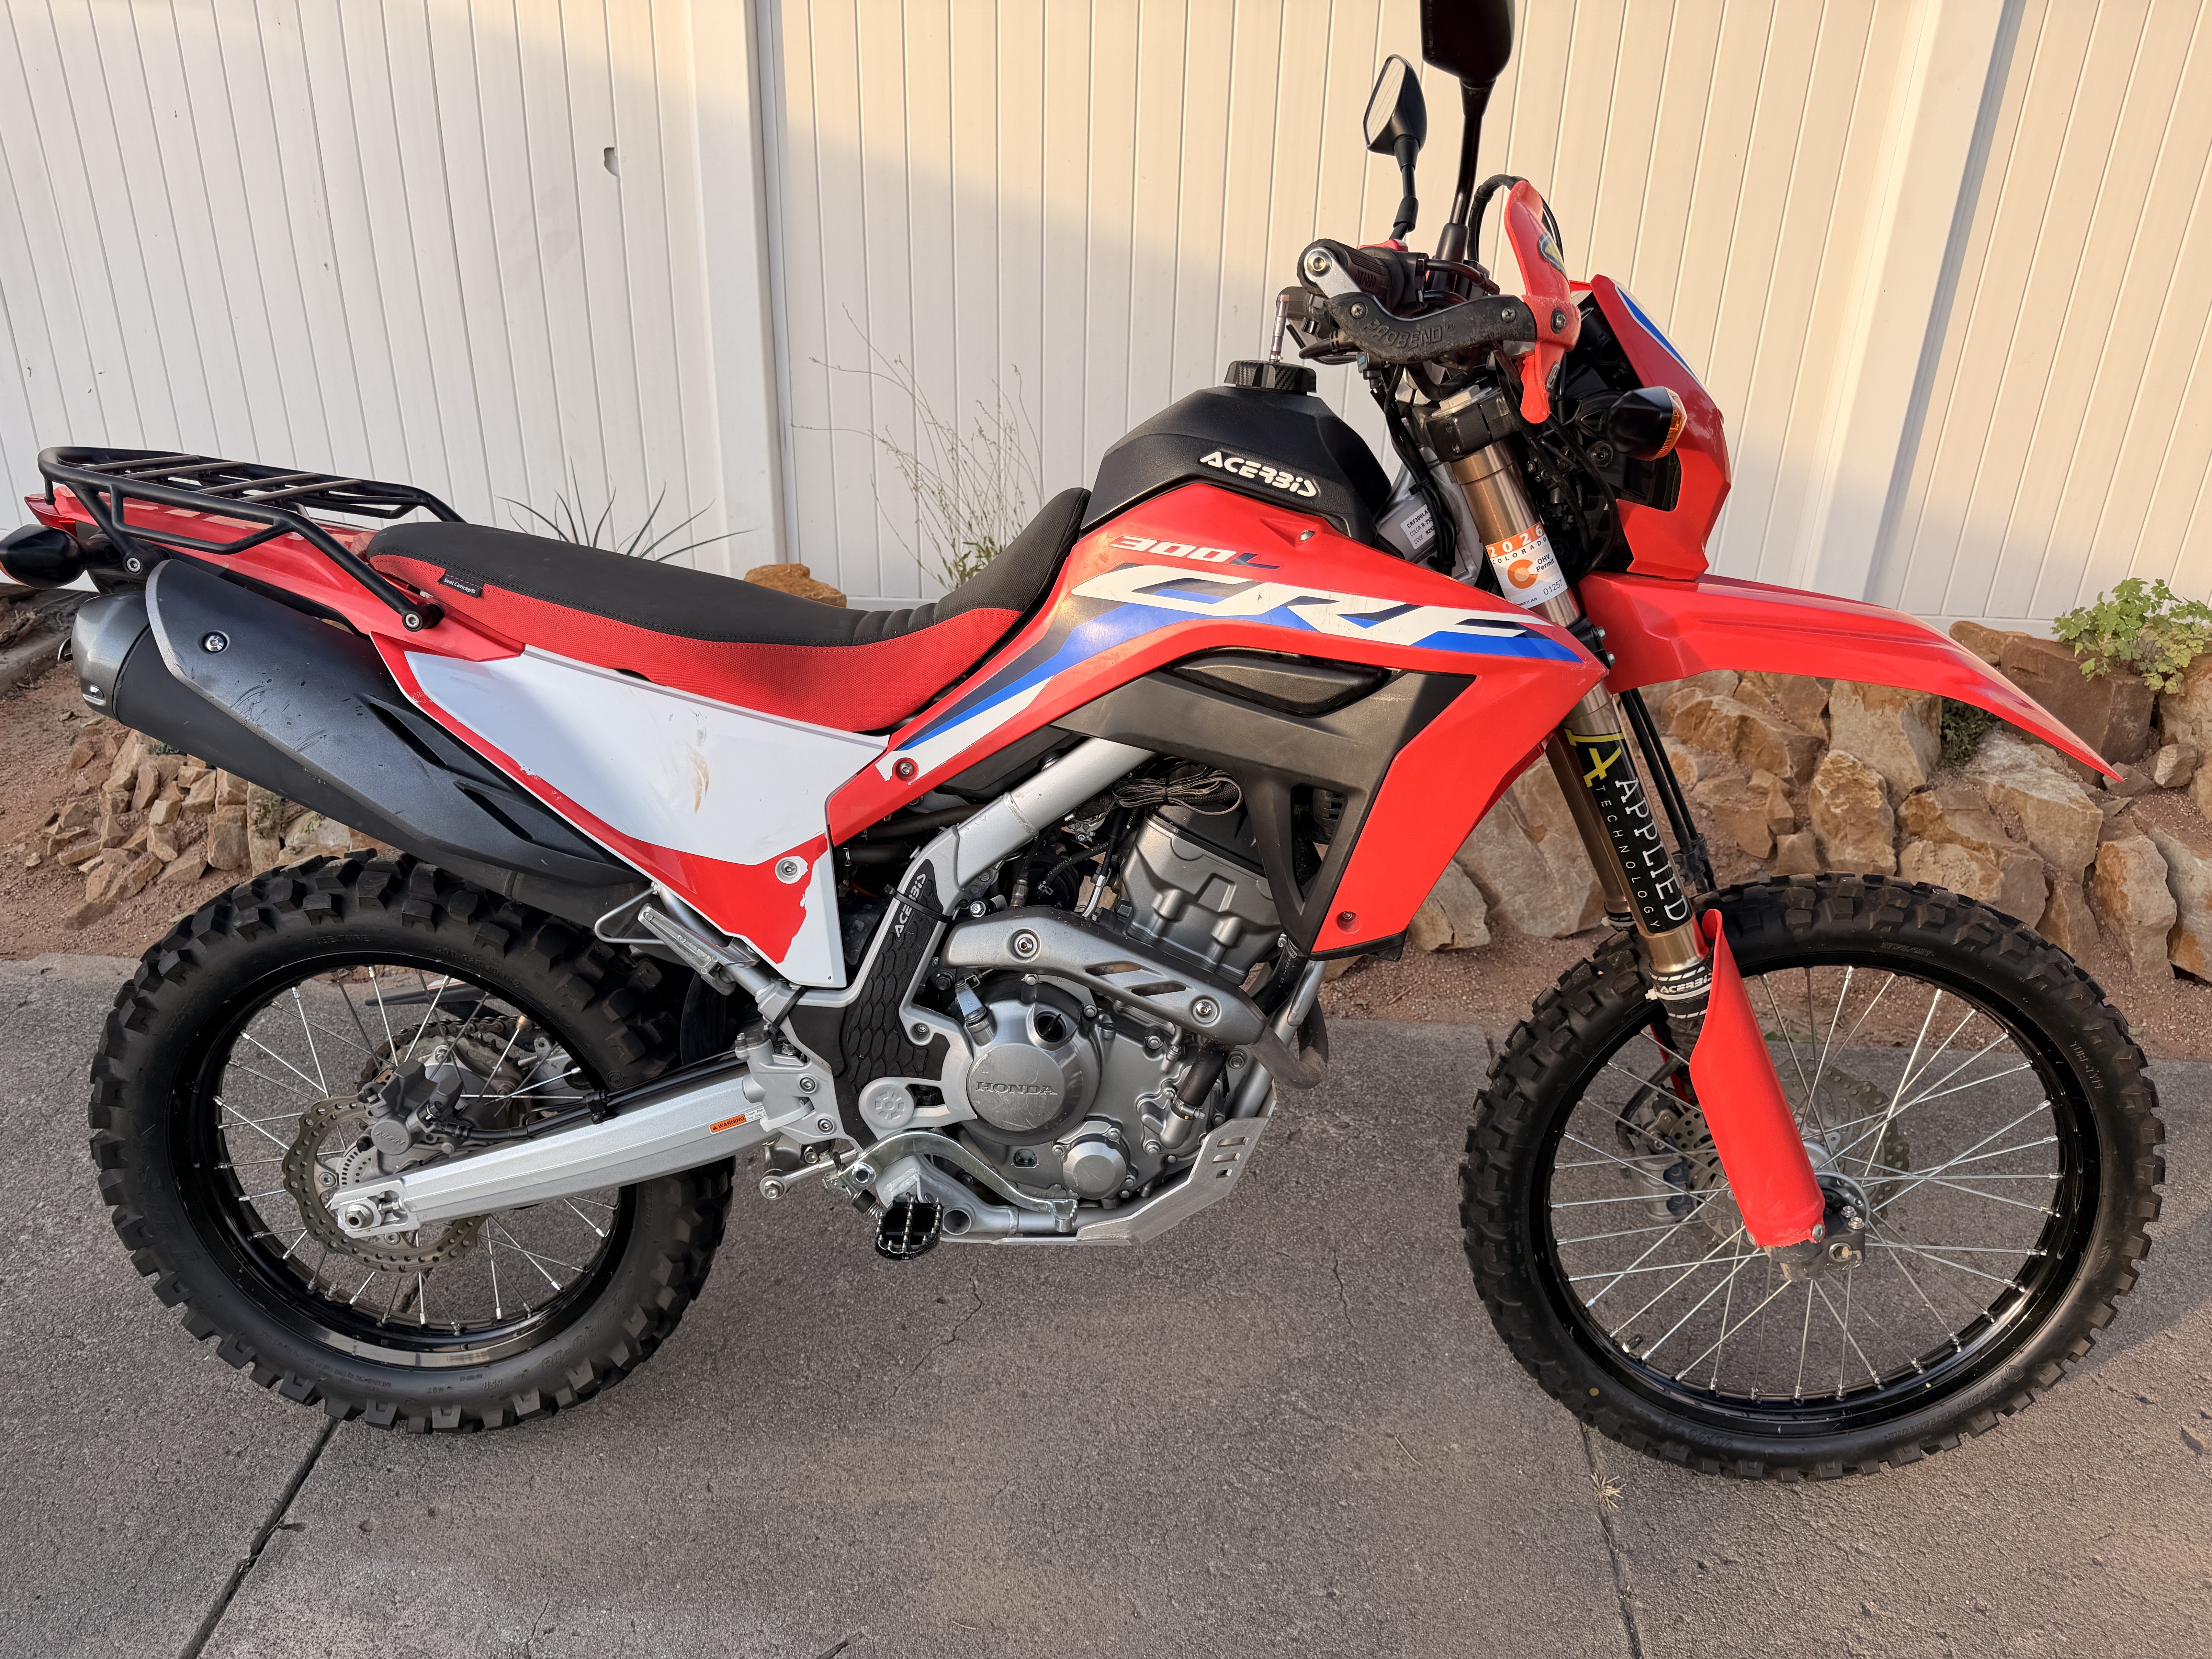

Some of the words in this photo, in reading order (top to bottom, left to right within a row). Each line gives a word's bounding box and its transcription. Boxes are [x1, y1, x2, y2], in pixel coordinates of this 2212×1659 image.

[1410, 525, 1422, 537] COLOR
[1414, 534, 1424, 544] CODE
[1487, 524, 1543, 558] 2026
[1109, 535, 1281, 570] 300L
[1492, 537, 1547, 565] COLORADO
[1536, 558, 1555, 572] Permit
[1537, 553, 1550, 565] OHV
[454, 582, 476, 594] Concepts
[1543, 579, 1563, 595] 01257
[1071, 565, 1555, 646] CRF
[1595, 785, 1661, 927] TECHNOLOGY
[1614, 777, 1688, 921] APPLIED
[975, 1081, 1058, 1096] HONDA
[718, 1116, 745, 1128] WARNING
